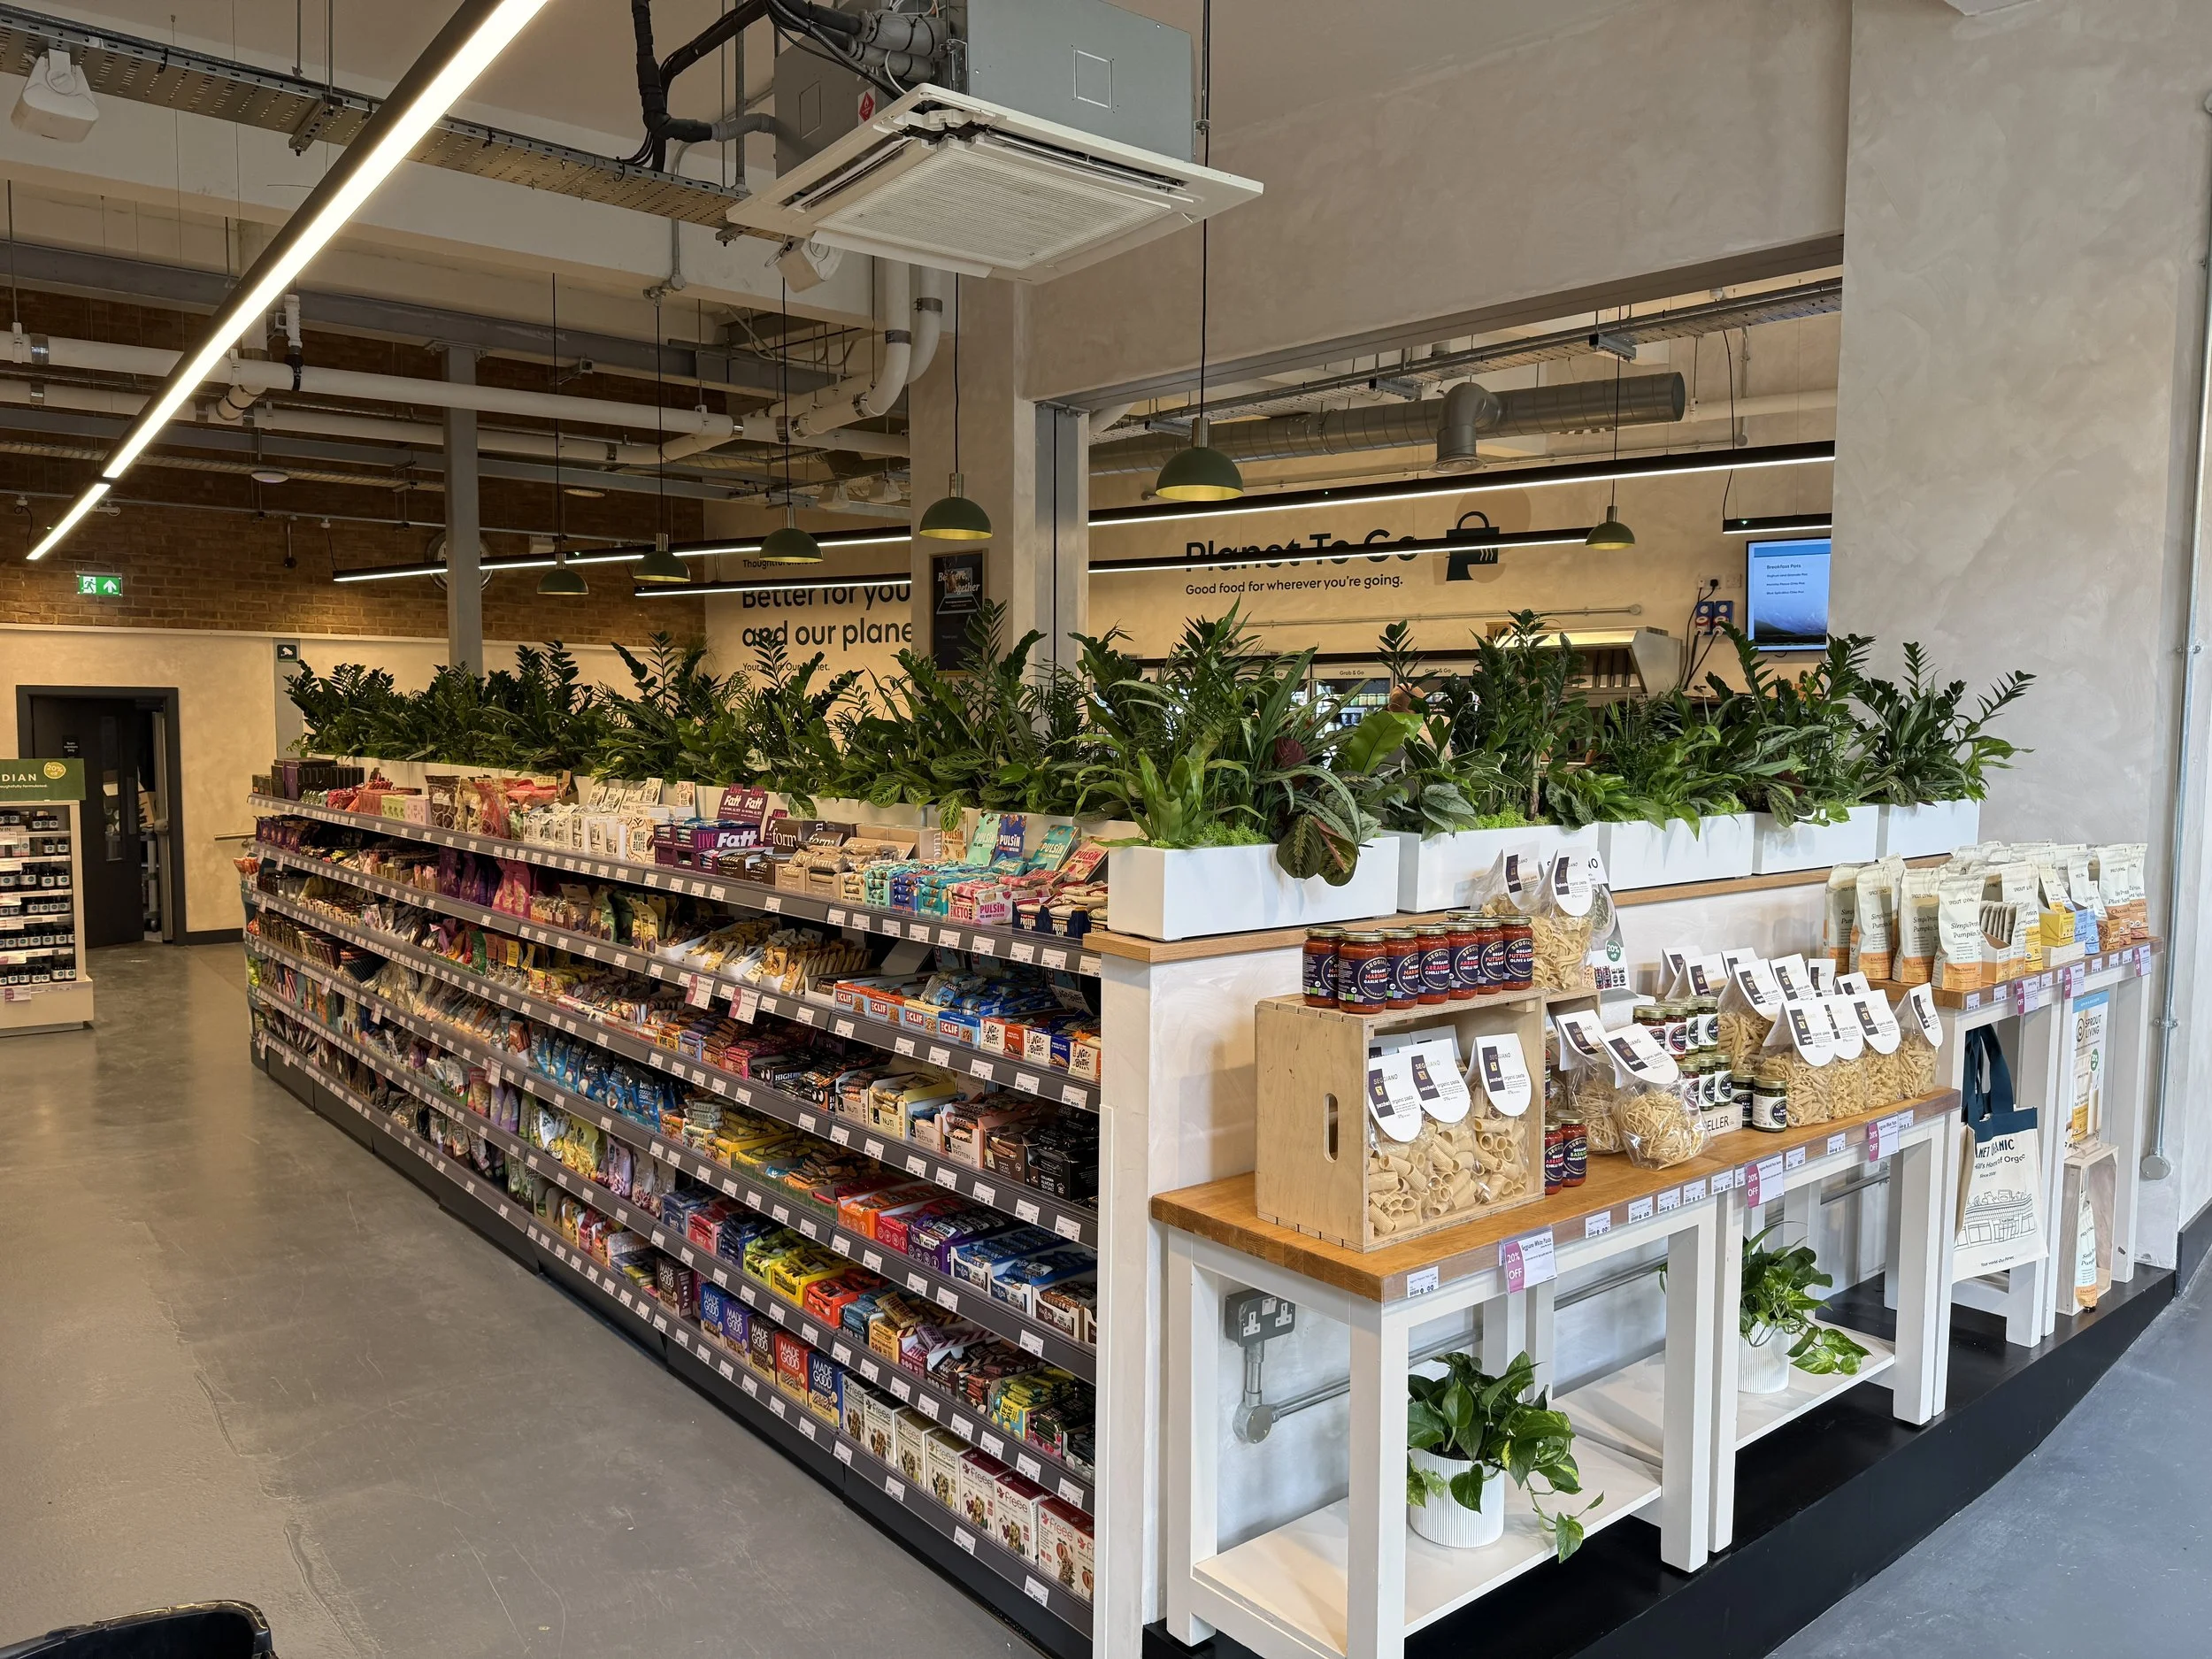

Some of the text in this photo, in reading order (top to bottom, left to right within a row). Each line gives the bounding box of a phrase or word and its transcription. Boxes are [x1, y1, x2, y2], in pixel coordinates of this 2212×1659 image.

[1186, 584, 1217, 595] Good
[1219, 582, 1246, 595] food
[1248, 580, 1264, 593] for
[1266, 579, 1322, 591] wherever
[1363, 574, 1403, 588] going.
[742, 584, 910, 611] Better for you
[795, 625, 836, 646] our
[697, 833, 716, 849] LIVE
[772, 828, 797, 846] form
[954, 907, 968, 919] KETO
[1607, 944, 1620, 954] 20%
[840, 993, 852, 1004] CLIF
[873, 1002, 887, 1014] CLIF
[909, 1013, 924, 1025] CLIF
[2085, 1014, 2101, 1028] SPROUT
[943, 1023, 959, 1036] CLIF
[2085, 1025, 2100, 1039] LIVING
[1416, 1060, 1440, 1070] SEGGIANO
[1373, 1073, 1398, 1085] SEGGIANO
[1705, 1116, 1729, 1132] ELLER
[1869, 1143, 1878, 1152] OFF
[1747, 1187, 1758, 1197] OFF
[1507, 1250, 1521, 1264] 20%
[659, 1262, 674, 1277] MADE
[1509, 1268, 1523, 1280] OFF
[659, 1271, 674, 1288] GOOD
[703, 1288, 718, 1304] MADE
[703, 1300, 719, 1317] GOOD
[727, 1308, 742, 1322] MADE
[726, 1318, 743, 1334] GOOD
[752, 1324, 768, 1338] MADE
[752, 1333, 768, 1351] GOOD
[780, 1340, 799, 1356] MADE
[780, 1353, 799, 1370] GOOD
[813, 1358, 833, 1376] MADE
[812, 1371, 833, 1389] GOOD
[872, 1402, 891, 1422] freee
[902, 1423, 921, 1443] freee
[935, 1444, 956, 1465] freee
[971, 1467, 992, 1488] freee
[1005, 1492, 1028, 1513] freee
[1049, 1517, 1073, 1541] freee
